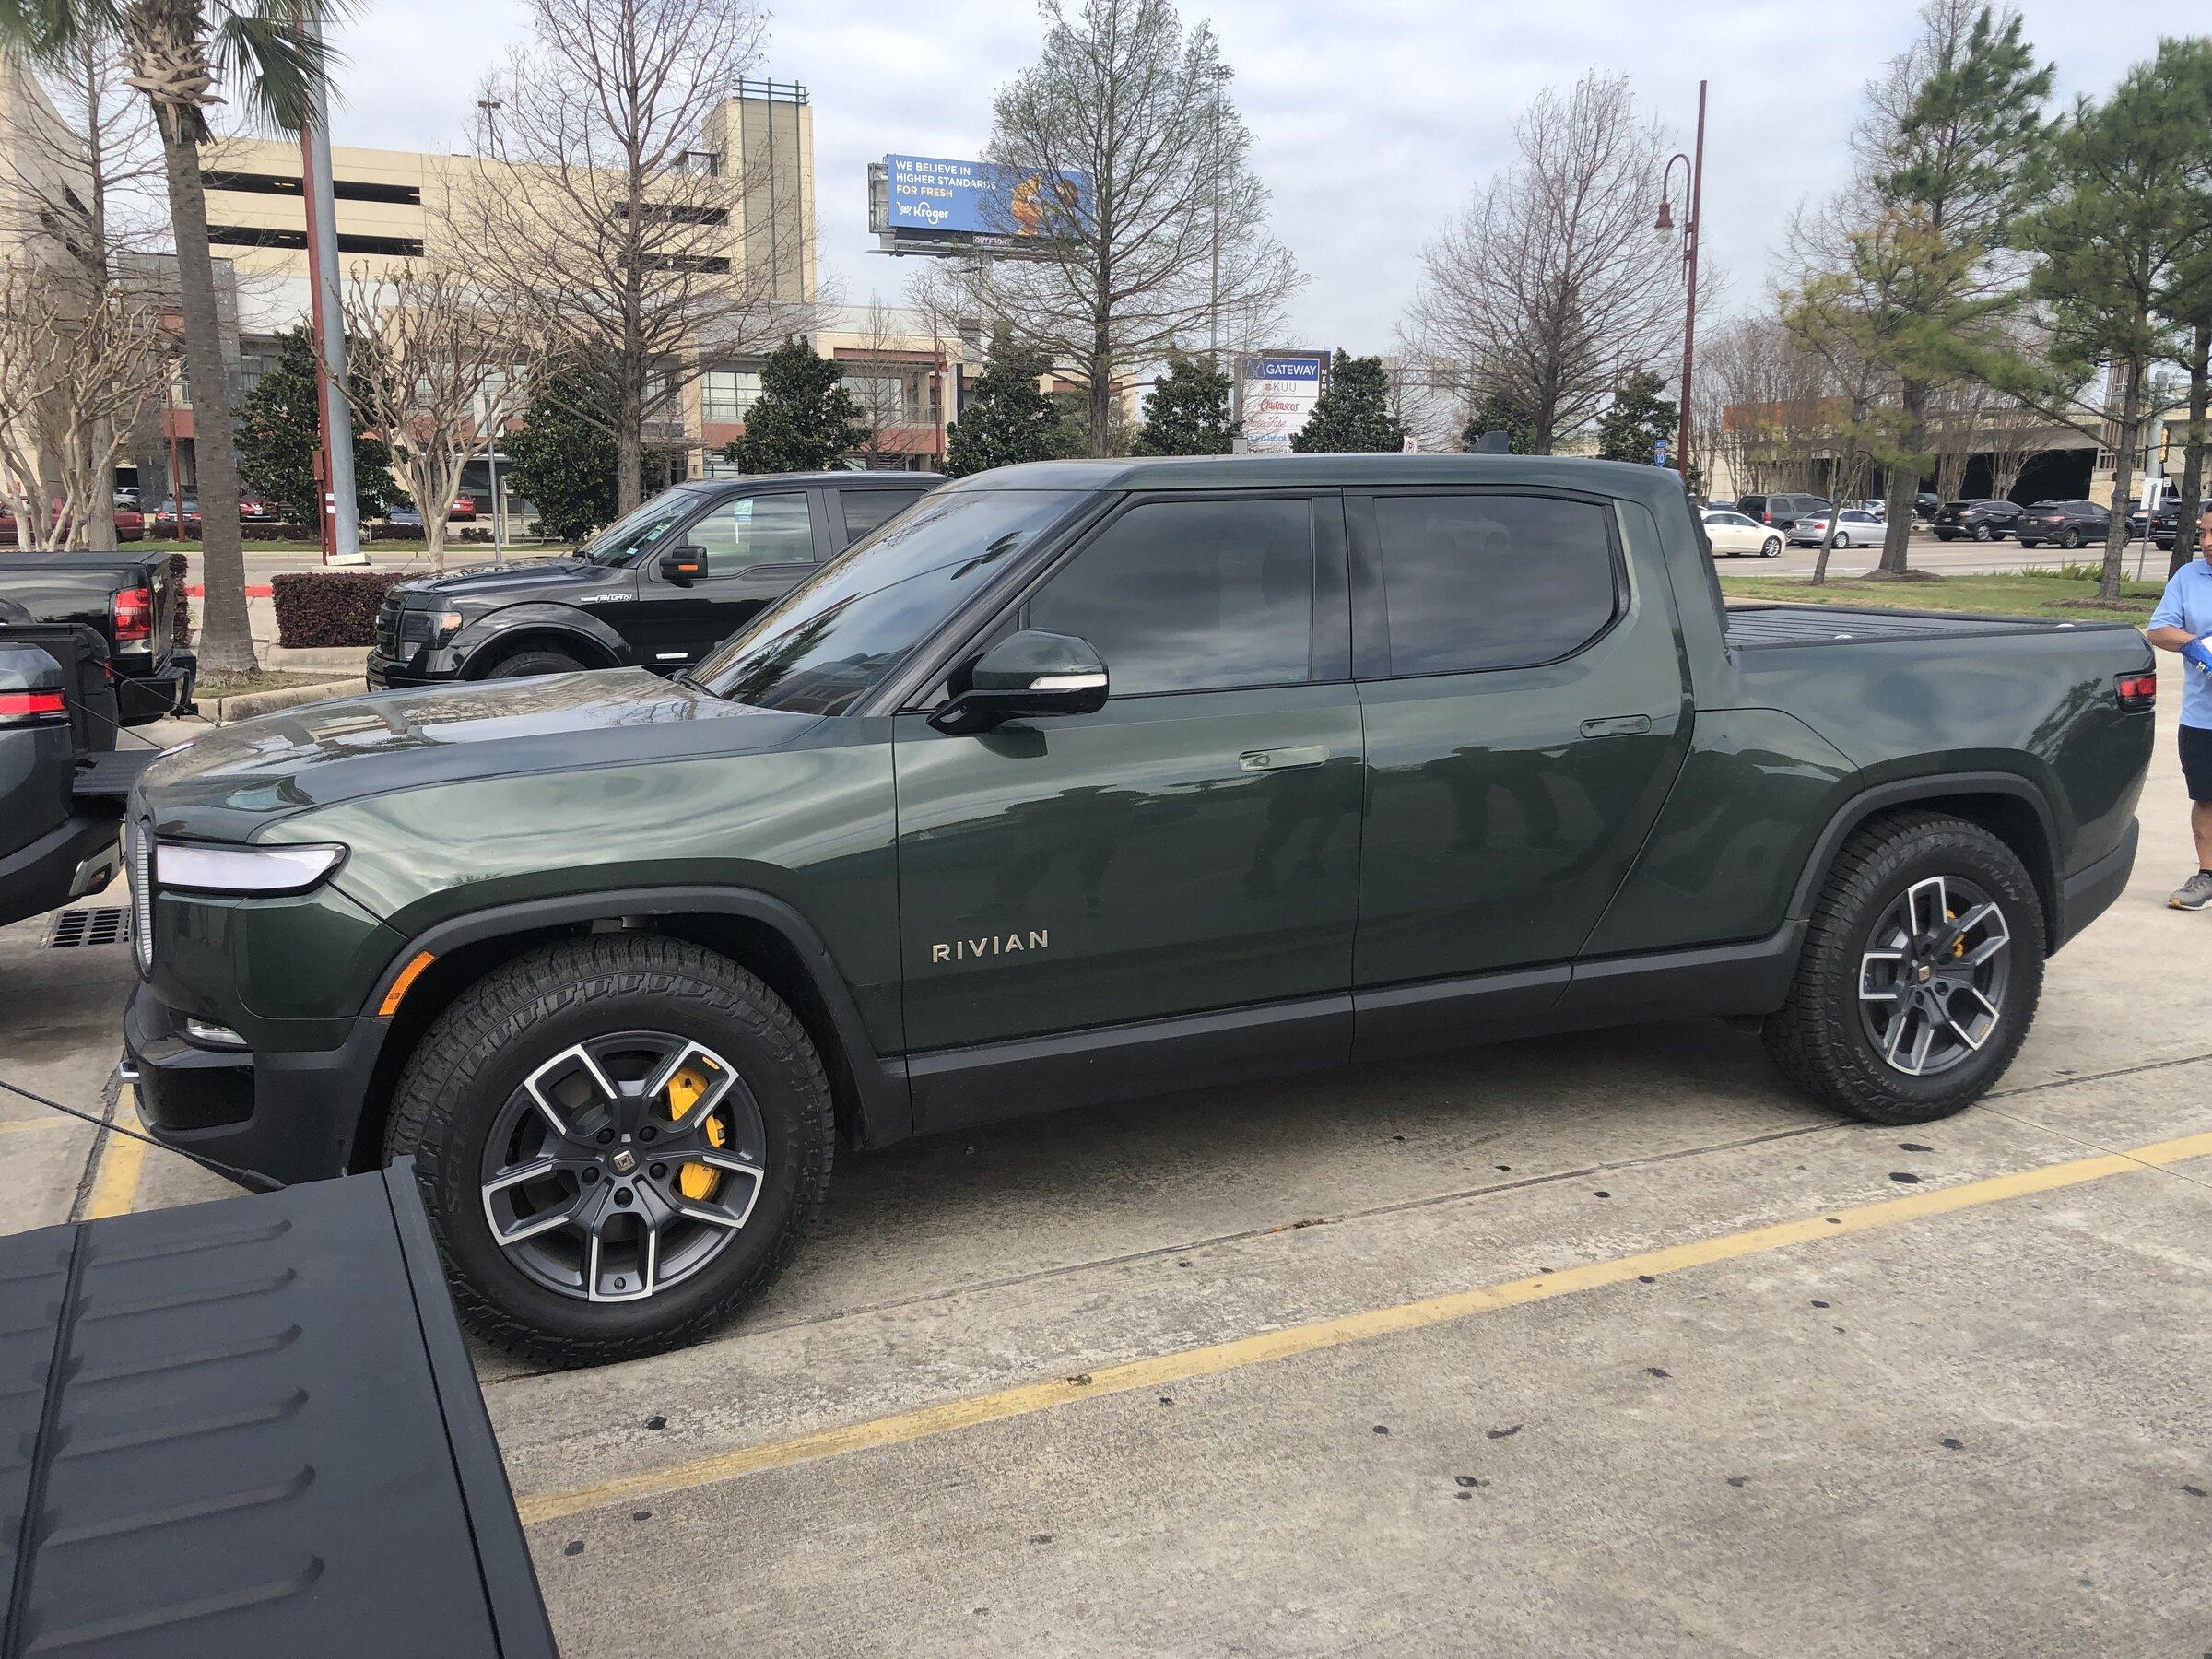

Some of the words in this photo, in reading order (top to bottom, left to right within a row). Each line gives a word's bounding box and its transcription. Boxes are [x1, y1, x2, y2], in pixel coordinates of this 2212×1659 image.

[896, 160, 912, 171] WE
[916, 162, 958, 175] BELIEVE
[960, 166, 971, 175] IN
[896, 172, 935, 184] HIGHER
[897, 184, 917, 195] FOR
[921, 187, 953, 197] FRESH
[913, 201, 948, 225] Kroger
[1266, 364, 1317, 375] GATEWAY
[1273, 382, 1297, 393] KUU
[932, 929, 1048, 963] RIVIAN
